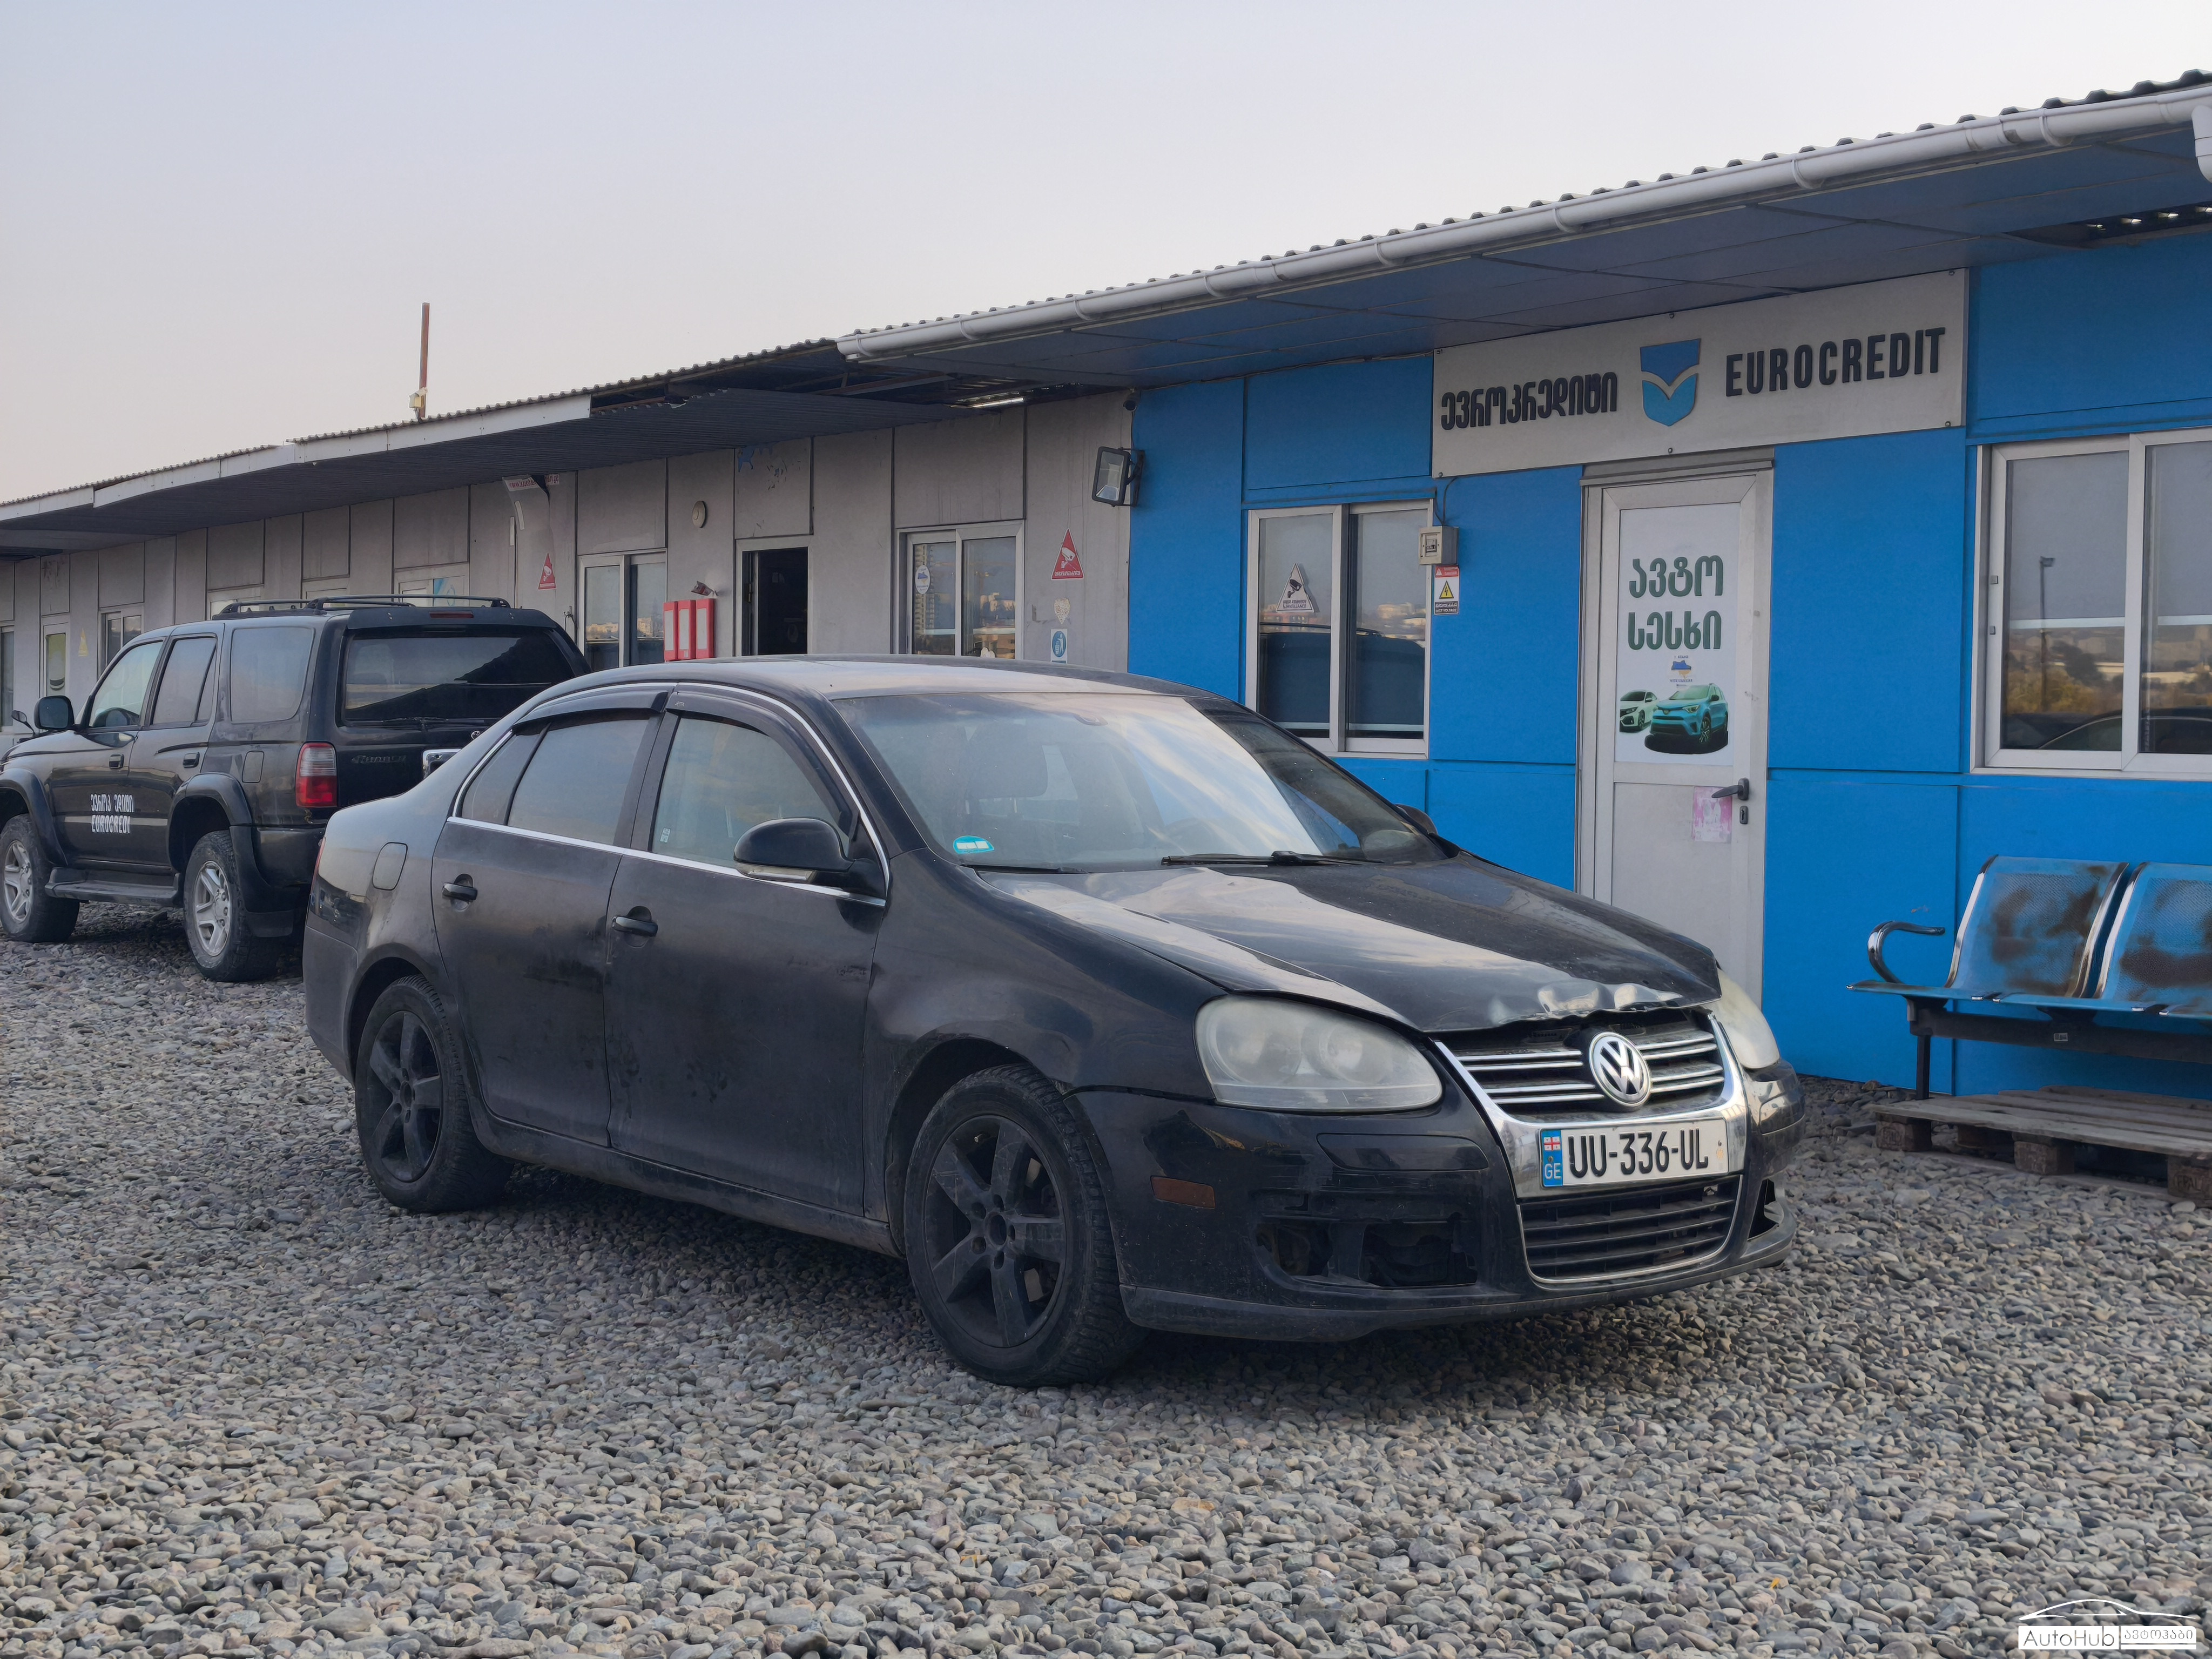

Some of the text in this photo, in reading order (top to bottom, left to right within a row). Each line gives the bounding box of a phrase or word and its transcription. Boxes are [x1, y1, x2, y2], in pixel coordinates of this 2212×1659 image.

[1726, 327, 1945, 396] EUROCREDIT
[1441, 372, 1617, 430] ევროკრედიტი
[1629, 555, 1723, 598] ავტო
[1628, 610, 1722, 650] სესხი
[1545, 1163, 1561, 1179] GE
[1568, 1128, 1708, 1177] UU-336-UL
